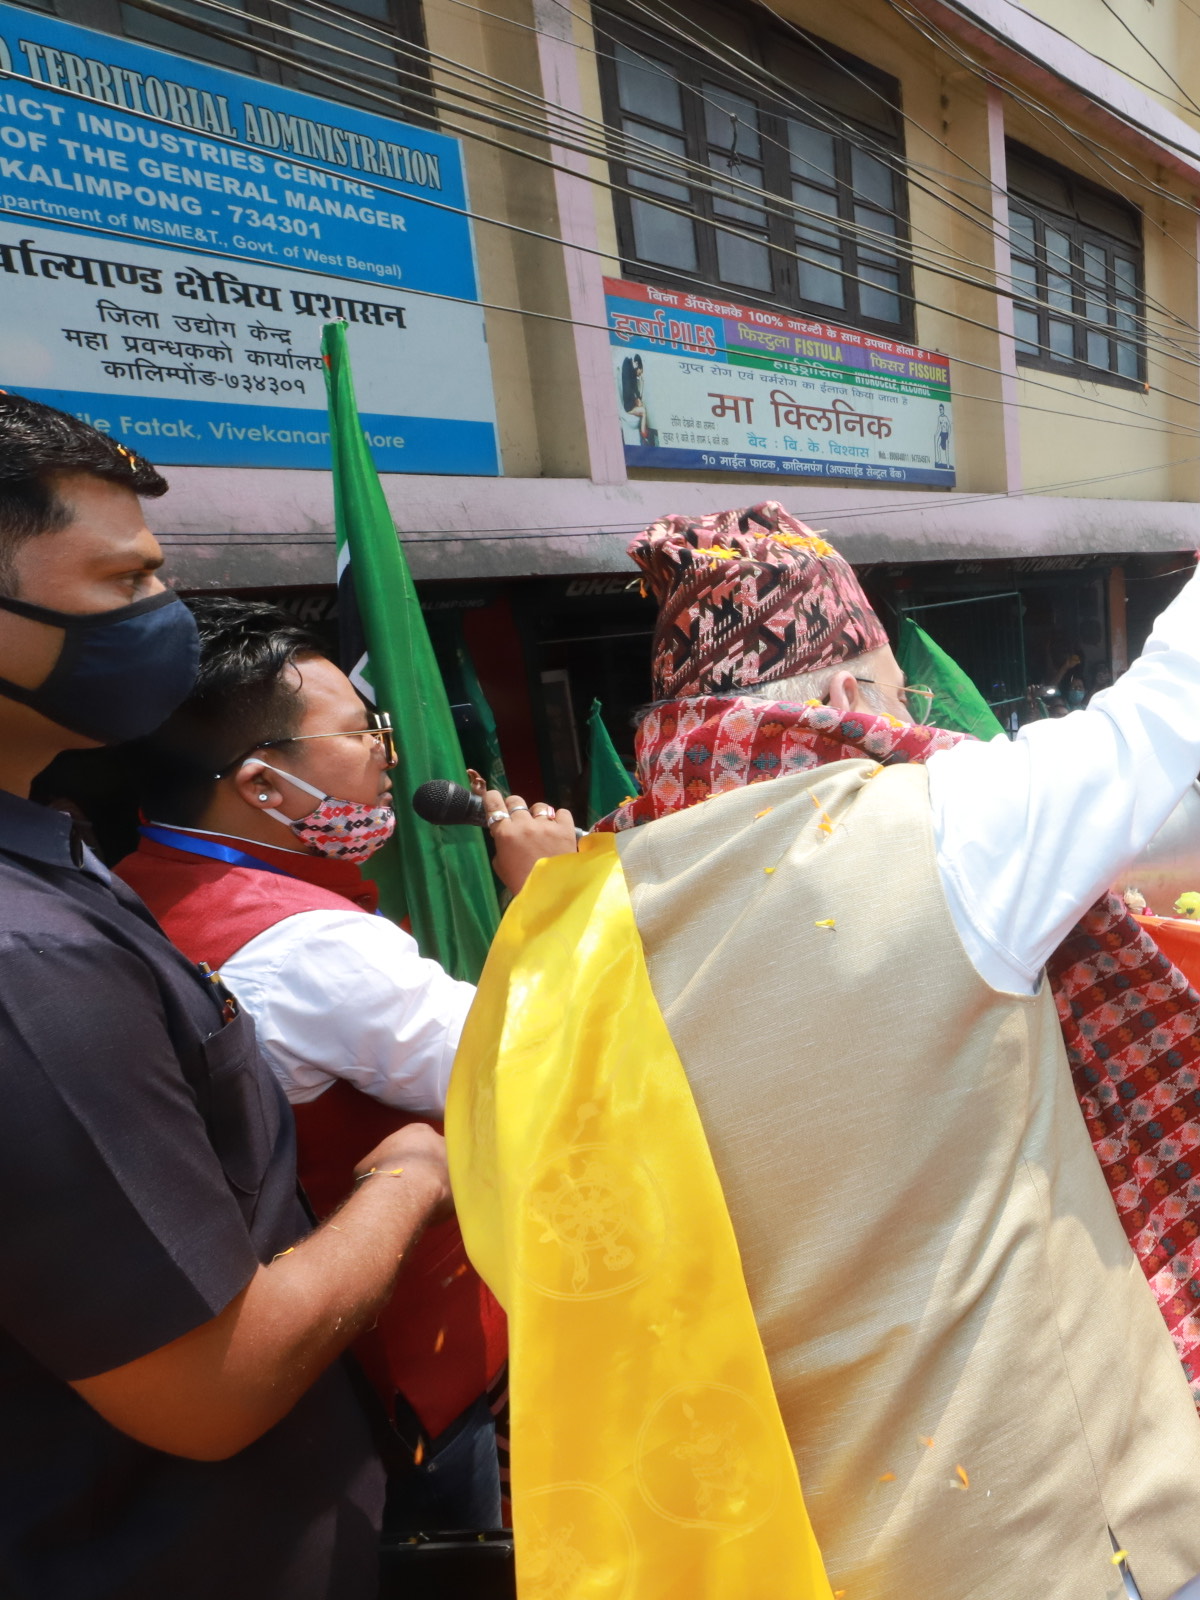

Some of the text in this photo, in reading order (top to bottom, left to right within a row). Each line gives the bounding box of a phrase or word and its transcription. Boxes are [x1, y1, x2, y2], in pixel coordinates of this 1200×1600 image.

[19, 39, 238, 138] TERRITORIAL
[243, 102, 442, 190] ADMINISTRATION
[1, 126, 407, 232] OF THE GENERAL MANAGER
[77, 111, 266, 175] INDUSTRIES
[274, 162, 376, 200] CENTRE
[0, 156, 203, 216] KALIMPONG
[227, 205, 321, 240] 734301
[0, 193, 402, 279] partment of MSME&T., Govt. of West Bengal)
[96, 299, 292, 346] जिला उद्योग केन्द्र
[174, 266, 283, 313] क्षेत्रिय
[290, 289, 407, 330] प्रशासन
[647, 286, 679, 305] बिना
[748, 311, 784, 328] 100%
[825, 325, 837, 338] के
[841, 330, 861, 344] साथ
[864, 337, 893, 352] उपचार
[896, 344, 914, 357] होता
[61, 328, 109, 352] महा
[668, 319, 717, 357] PILES
[737, 322, 844, 362] फिस्टुला FISTULA
[678, 361, 705, 376] गुप्त
[710, 364, 732, 379] रोग
[738, 370, 755, 381] एवं
[802, 380, 816, 391] का
[851, 387, 875, 400] किया
[878, 394, 899, 405] जाता
[869, 352, 948, 383] फिसर FISSURE
[119, 416, 201, 440] Fatak,
[707, 388, 893, 440] मा क्लिनिक
[702, 454, 716, 466] १०
[720, 453, 746, 469] माईल
